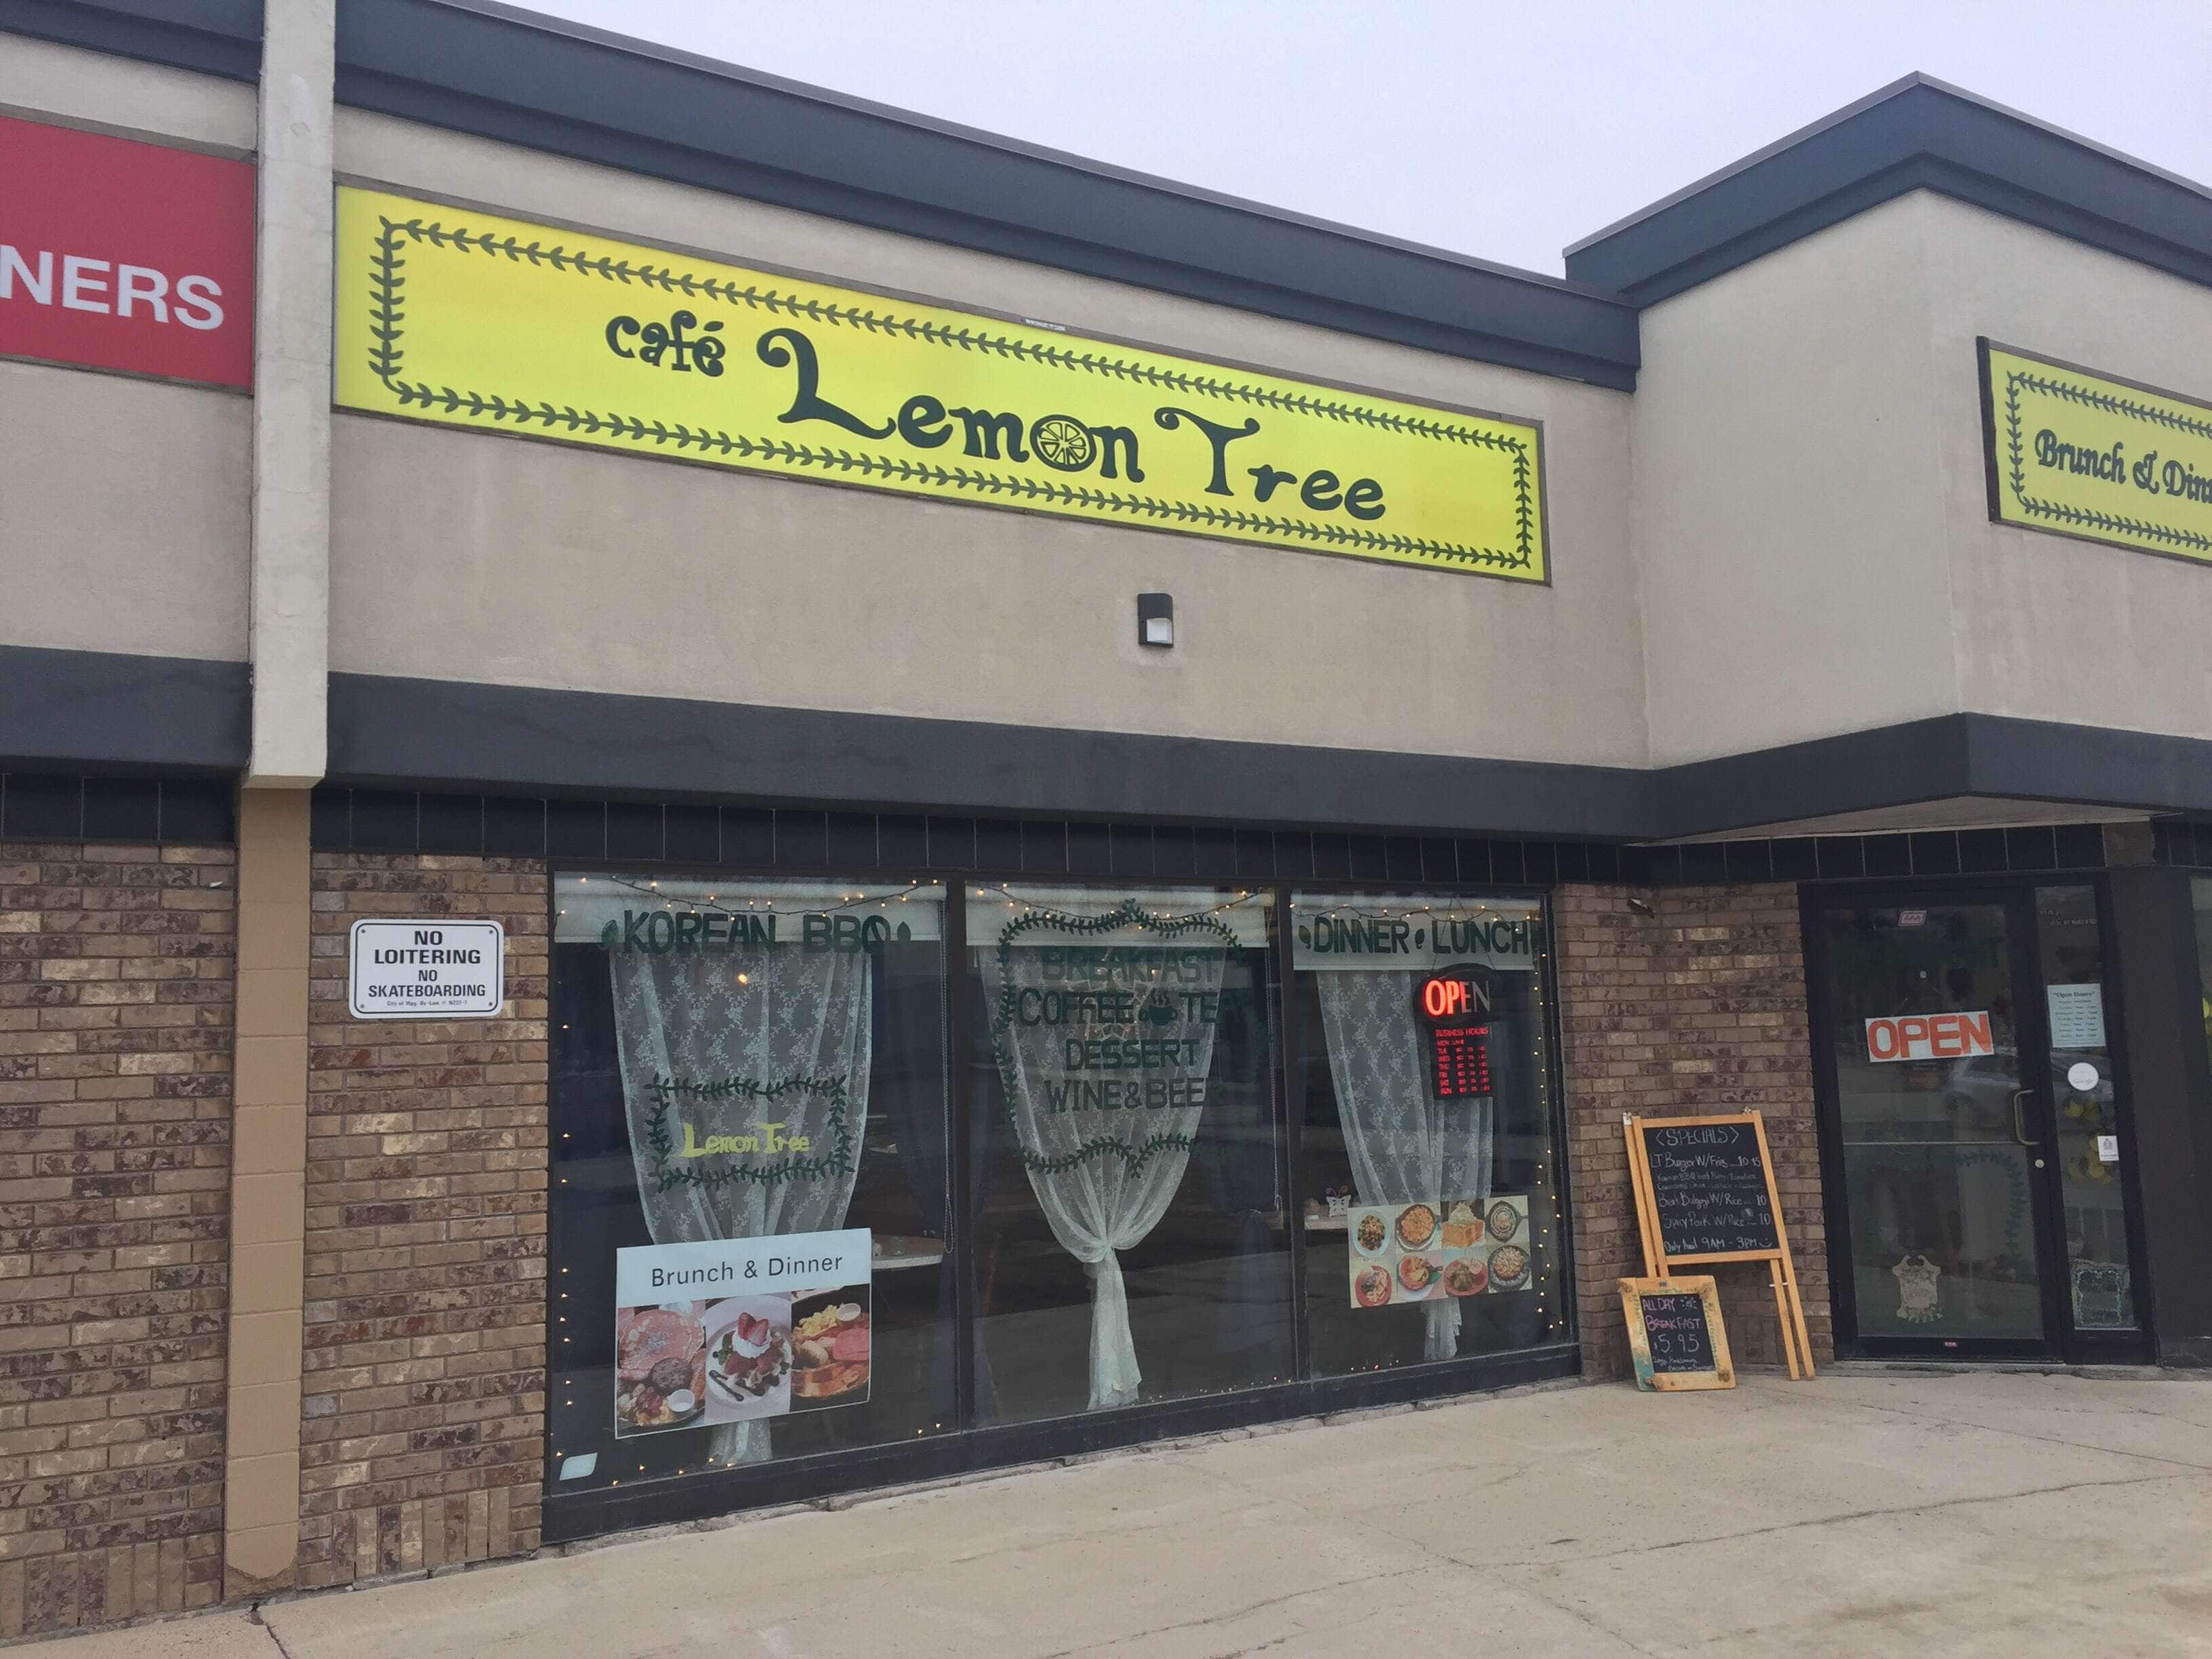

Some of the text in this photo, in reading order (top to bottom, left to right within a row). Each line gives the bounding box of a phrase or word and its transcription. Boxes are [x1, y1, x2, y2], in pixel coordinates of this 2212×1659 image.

[0, 244, 224, 330] NERS
[605, 310, 726, 377] café
[756, 327, 1386, 520] Lemon Tree
[2035, 429, 2127, 484] Brunch
[414, 930, 443, 945] NO
[623, 909, 891, 954] KOREAN BBQ
[1313, 916, 1529, 955] DINNER LUNCH
[374, 949, 481, 964] LOITERING
[368, 985, 486, 998] SKATEBOARDING
[418, 970, 438, 982] NO
[1018, 988, 1219, 1026] COFFEE TE
[1425, 980, 1491, 1016] OPEN
[1868, 1014, 1993, 1060] OPEN
[1065, 1039, 1200, 1071] DESSERT
[682, 1122, 759, 1158] Lemon
[1756, 1194, 1767, 1206] 10
[1759, 1213, 1771, 1226] 10
[1701, 1236, 1725, 1250] 9AM
[1736, 1235, 1757, 1250] 3PM
[651, 1256, 843, 1288] Brunch & Dinner
[1642, 1297, 1676, 1313] ALL DAY
